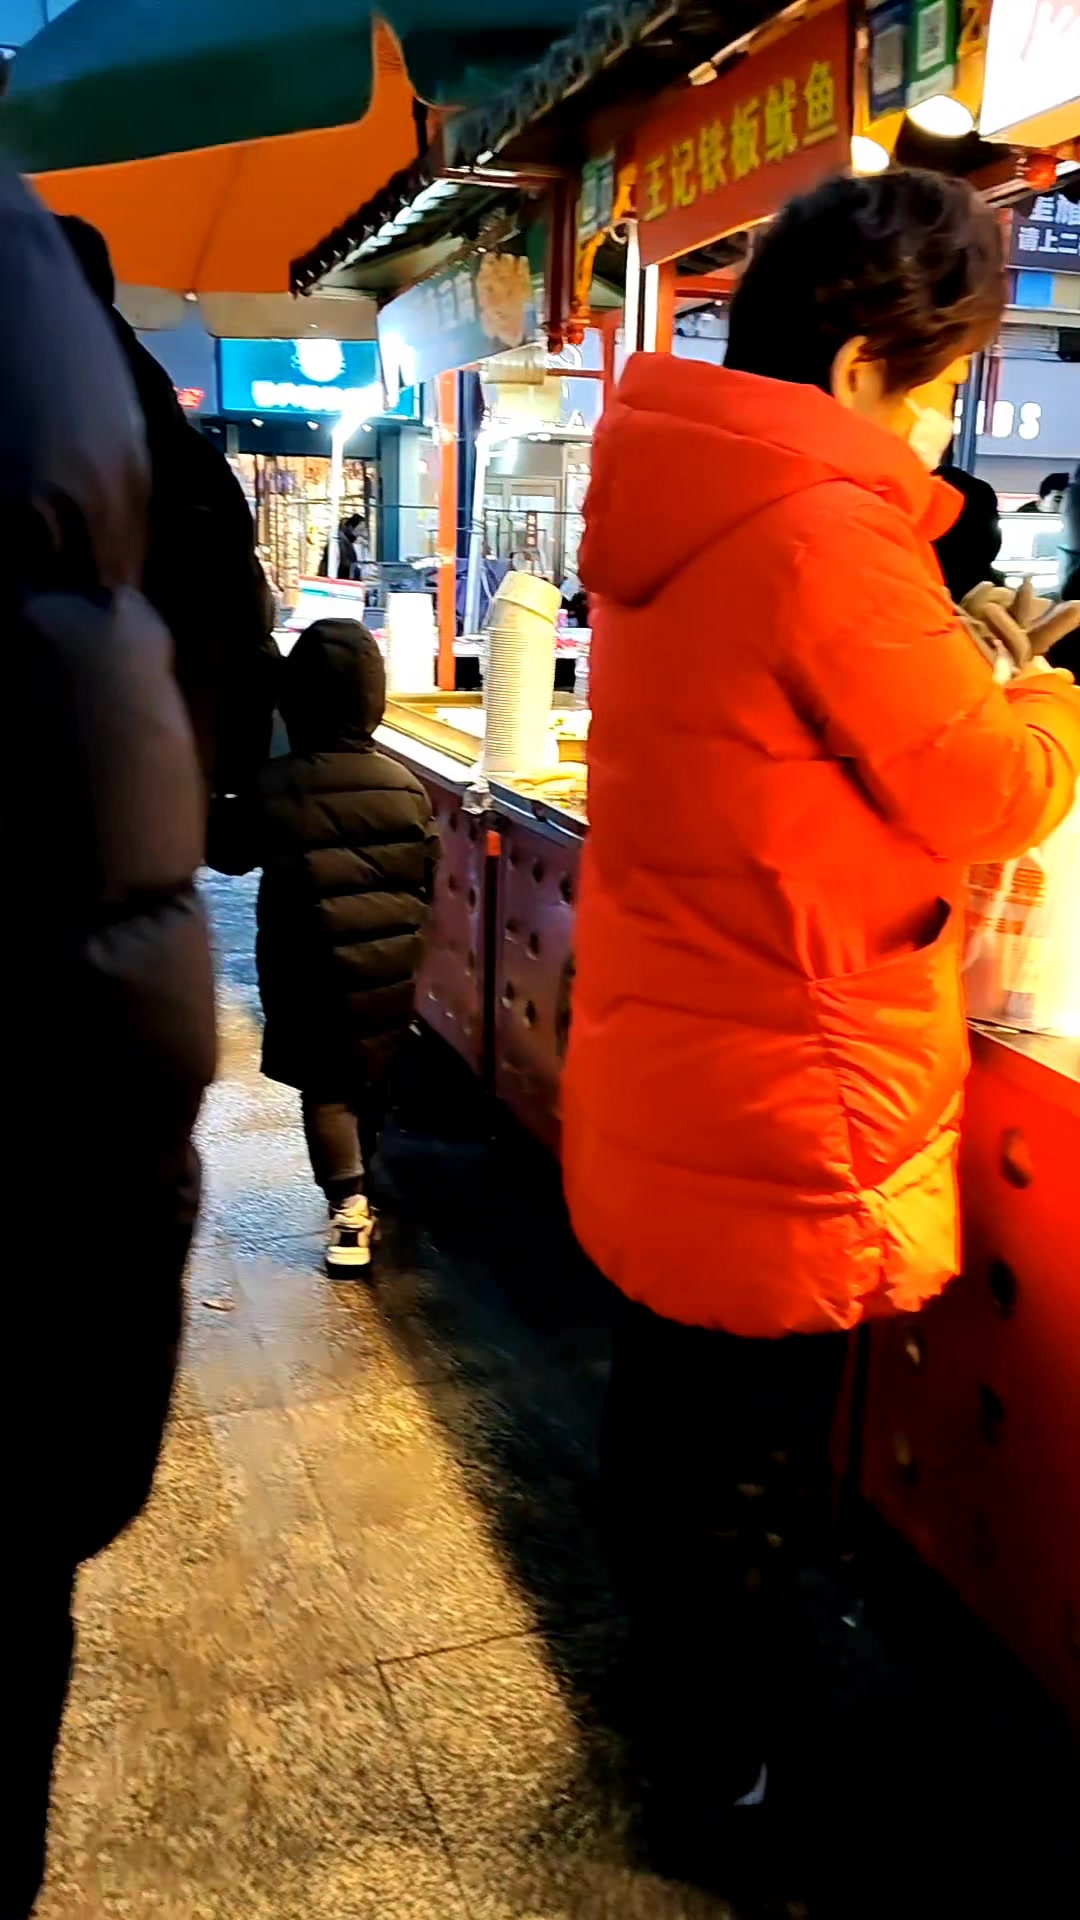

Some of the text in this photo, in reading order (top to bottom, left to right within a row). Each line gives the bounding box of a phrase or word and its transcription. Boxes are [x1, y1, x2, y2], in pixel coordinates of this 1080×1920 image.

[641, 61, 838, 222] 王记铁板鱿鱼
[1018, 226, 1080, 256] 请上二
